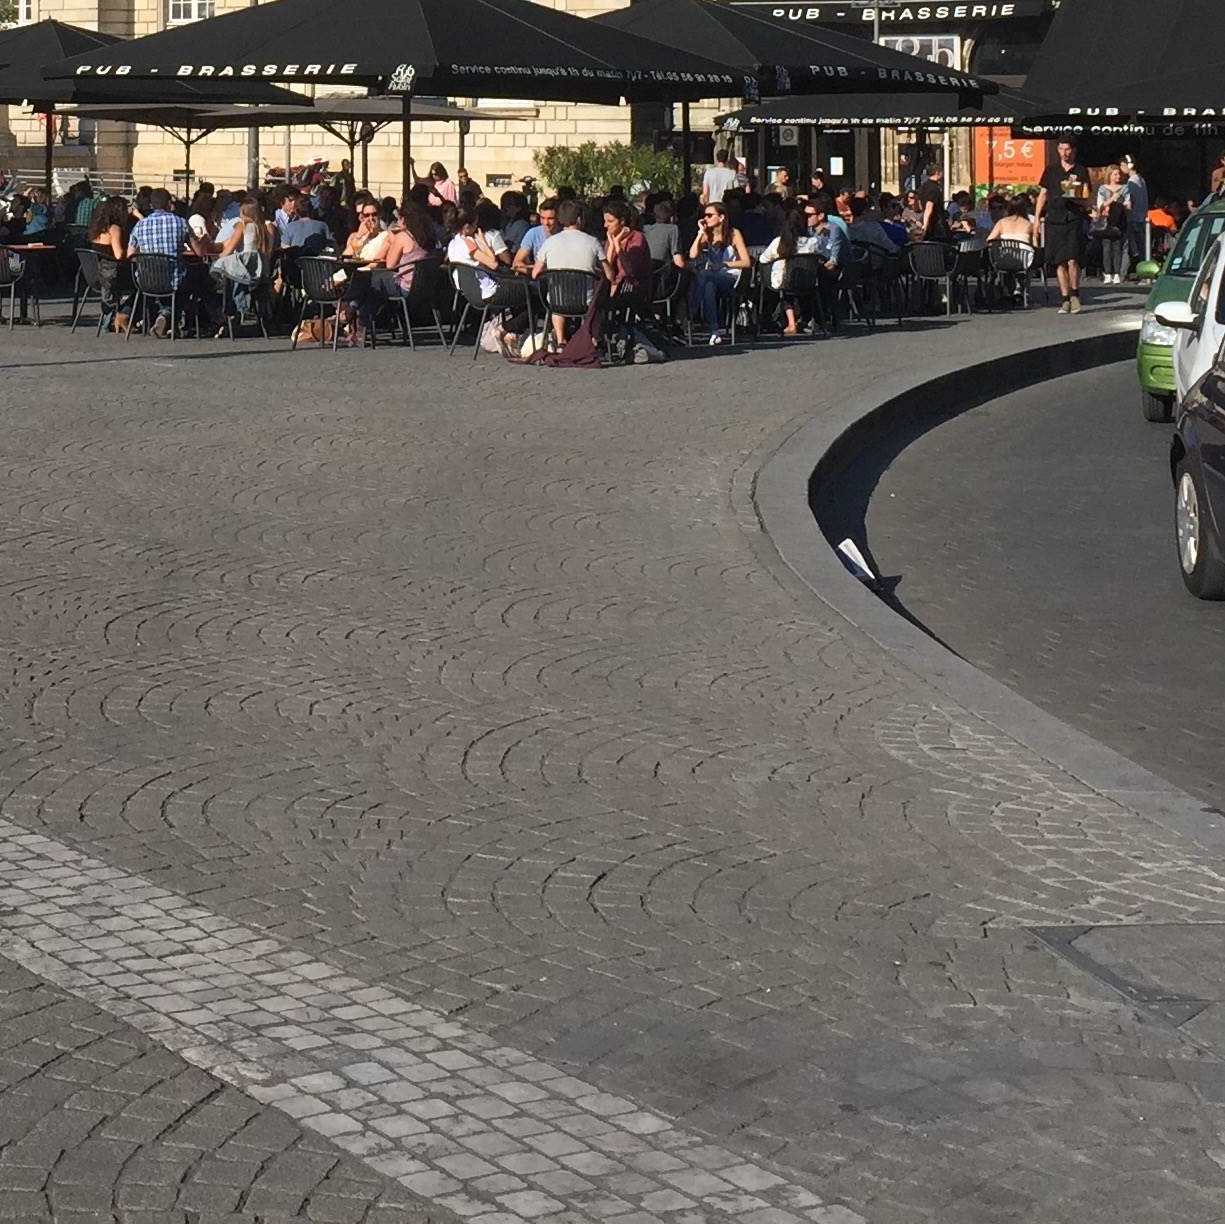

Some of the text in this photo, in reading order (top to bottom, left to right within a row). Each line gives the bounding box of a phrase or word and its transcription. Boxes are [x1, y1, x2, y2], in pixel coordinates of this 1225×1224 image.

[862, 4, 1016, 21] BRASSERIE
[76, 64, 131, 75] PUB
[176, 63, 357, 76] BRASSERIE
[451, 64, 491, 75] Service
[494, 65, 531, 75] continu
[582, 67, 594, 77] du
[810, 65, 848, 77] PUB
[878, 69, 980, 89] BRASSERIE
[1068, 107, 1119, 116] PUB
[1163, 107, 1225, 116] BRA
[750, 116, 782, 124] Service
[784, 116, 817, 124] continu
[876, 116, 901, 124] matin
[1022, 124, 1083, 135] Service
[1091, 124, 1155, 135] continu
[1163, 124, 1185, 135] de
